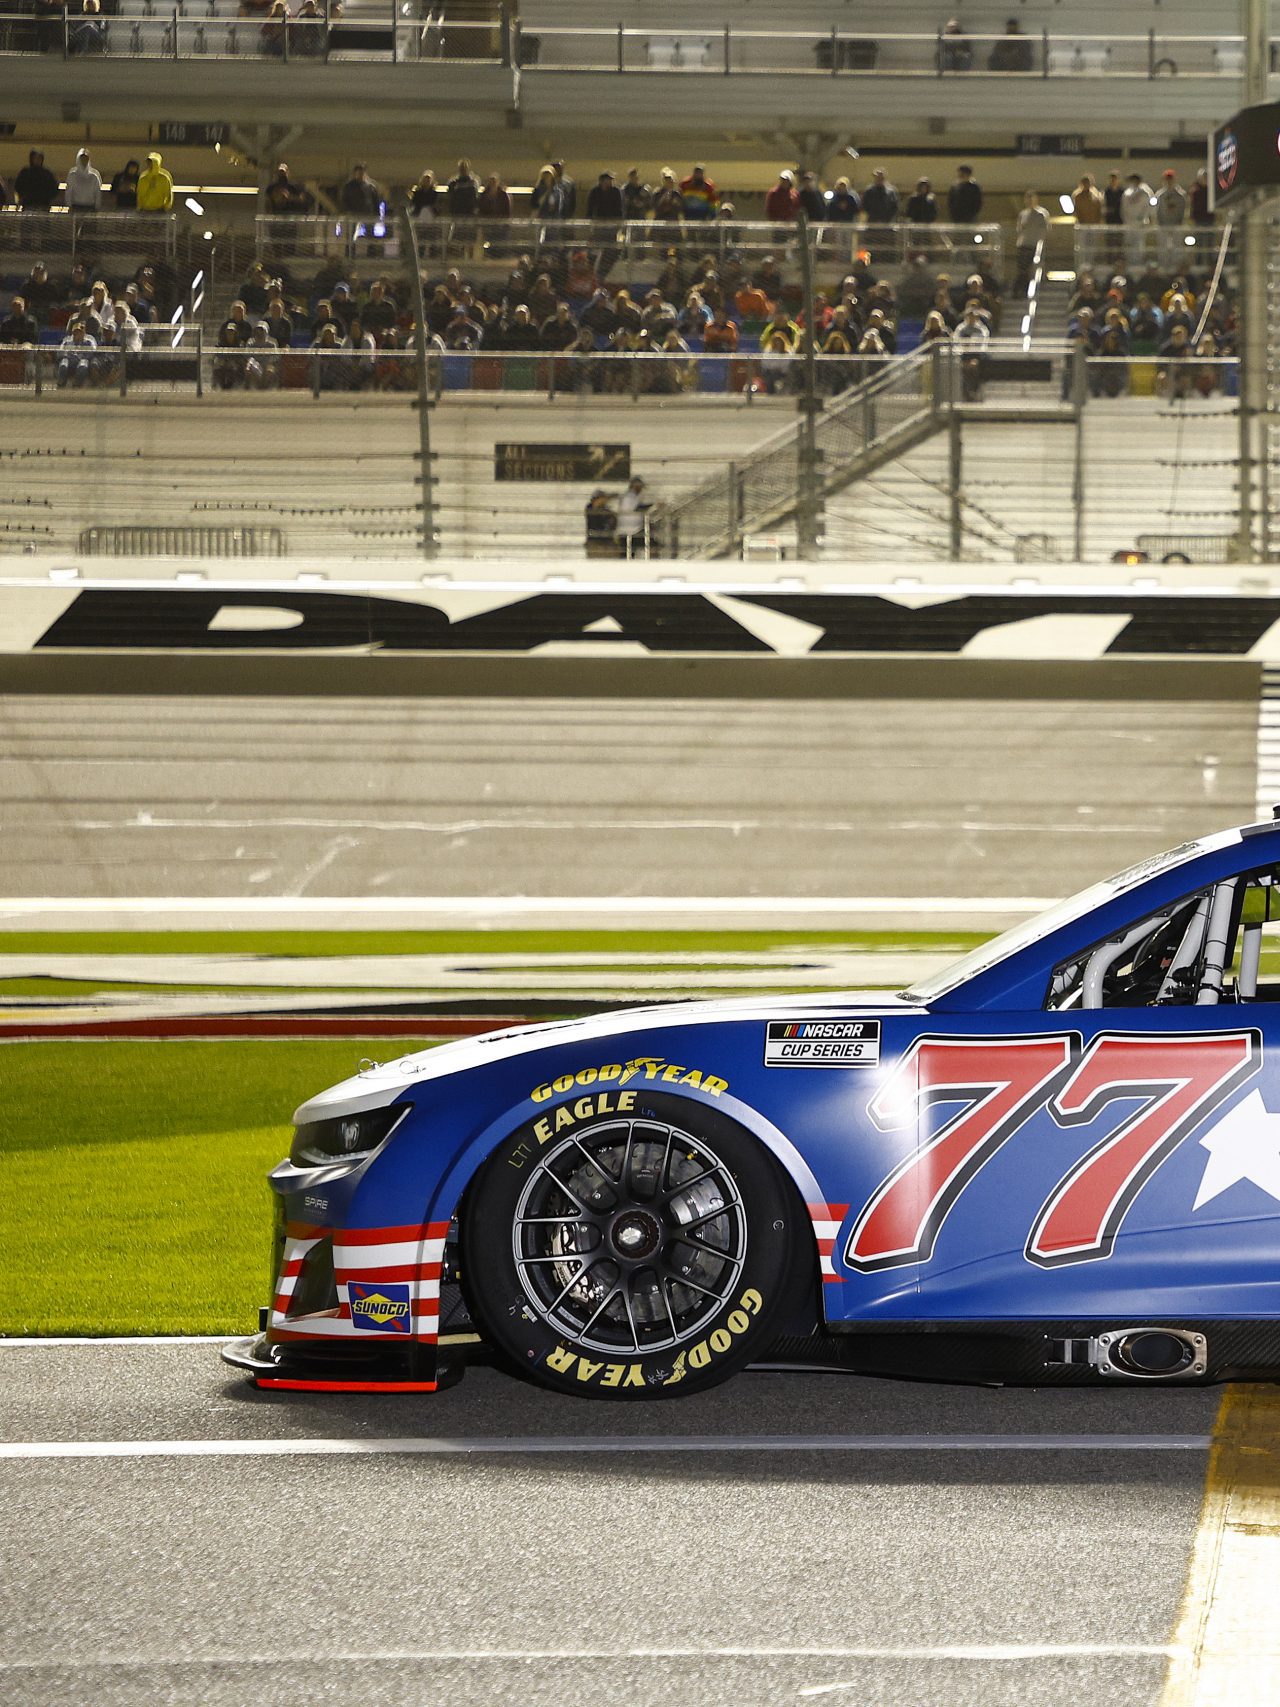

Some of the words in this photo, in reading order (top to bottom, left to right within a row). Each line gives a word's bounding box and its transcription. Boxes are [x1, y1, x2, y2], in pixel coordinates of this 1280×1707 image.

[505, 445, 527, 459] ALL
[802, 1024, 864, 1037] NASCAR
[781, 1044, 811, 1057] CUP
[812, 1044, 864, 1057] SERIES
[533, 1091, 638, 1146] EAGLE
[508, 1143, 532, 1169] L77
[843, 1027, 1264, 1275] 77
[304, 1196, 329, 1210] SPIRE
[355, 1302, 406, 1316] SUNOCO
